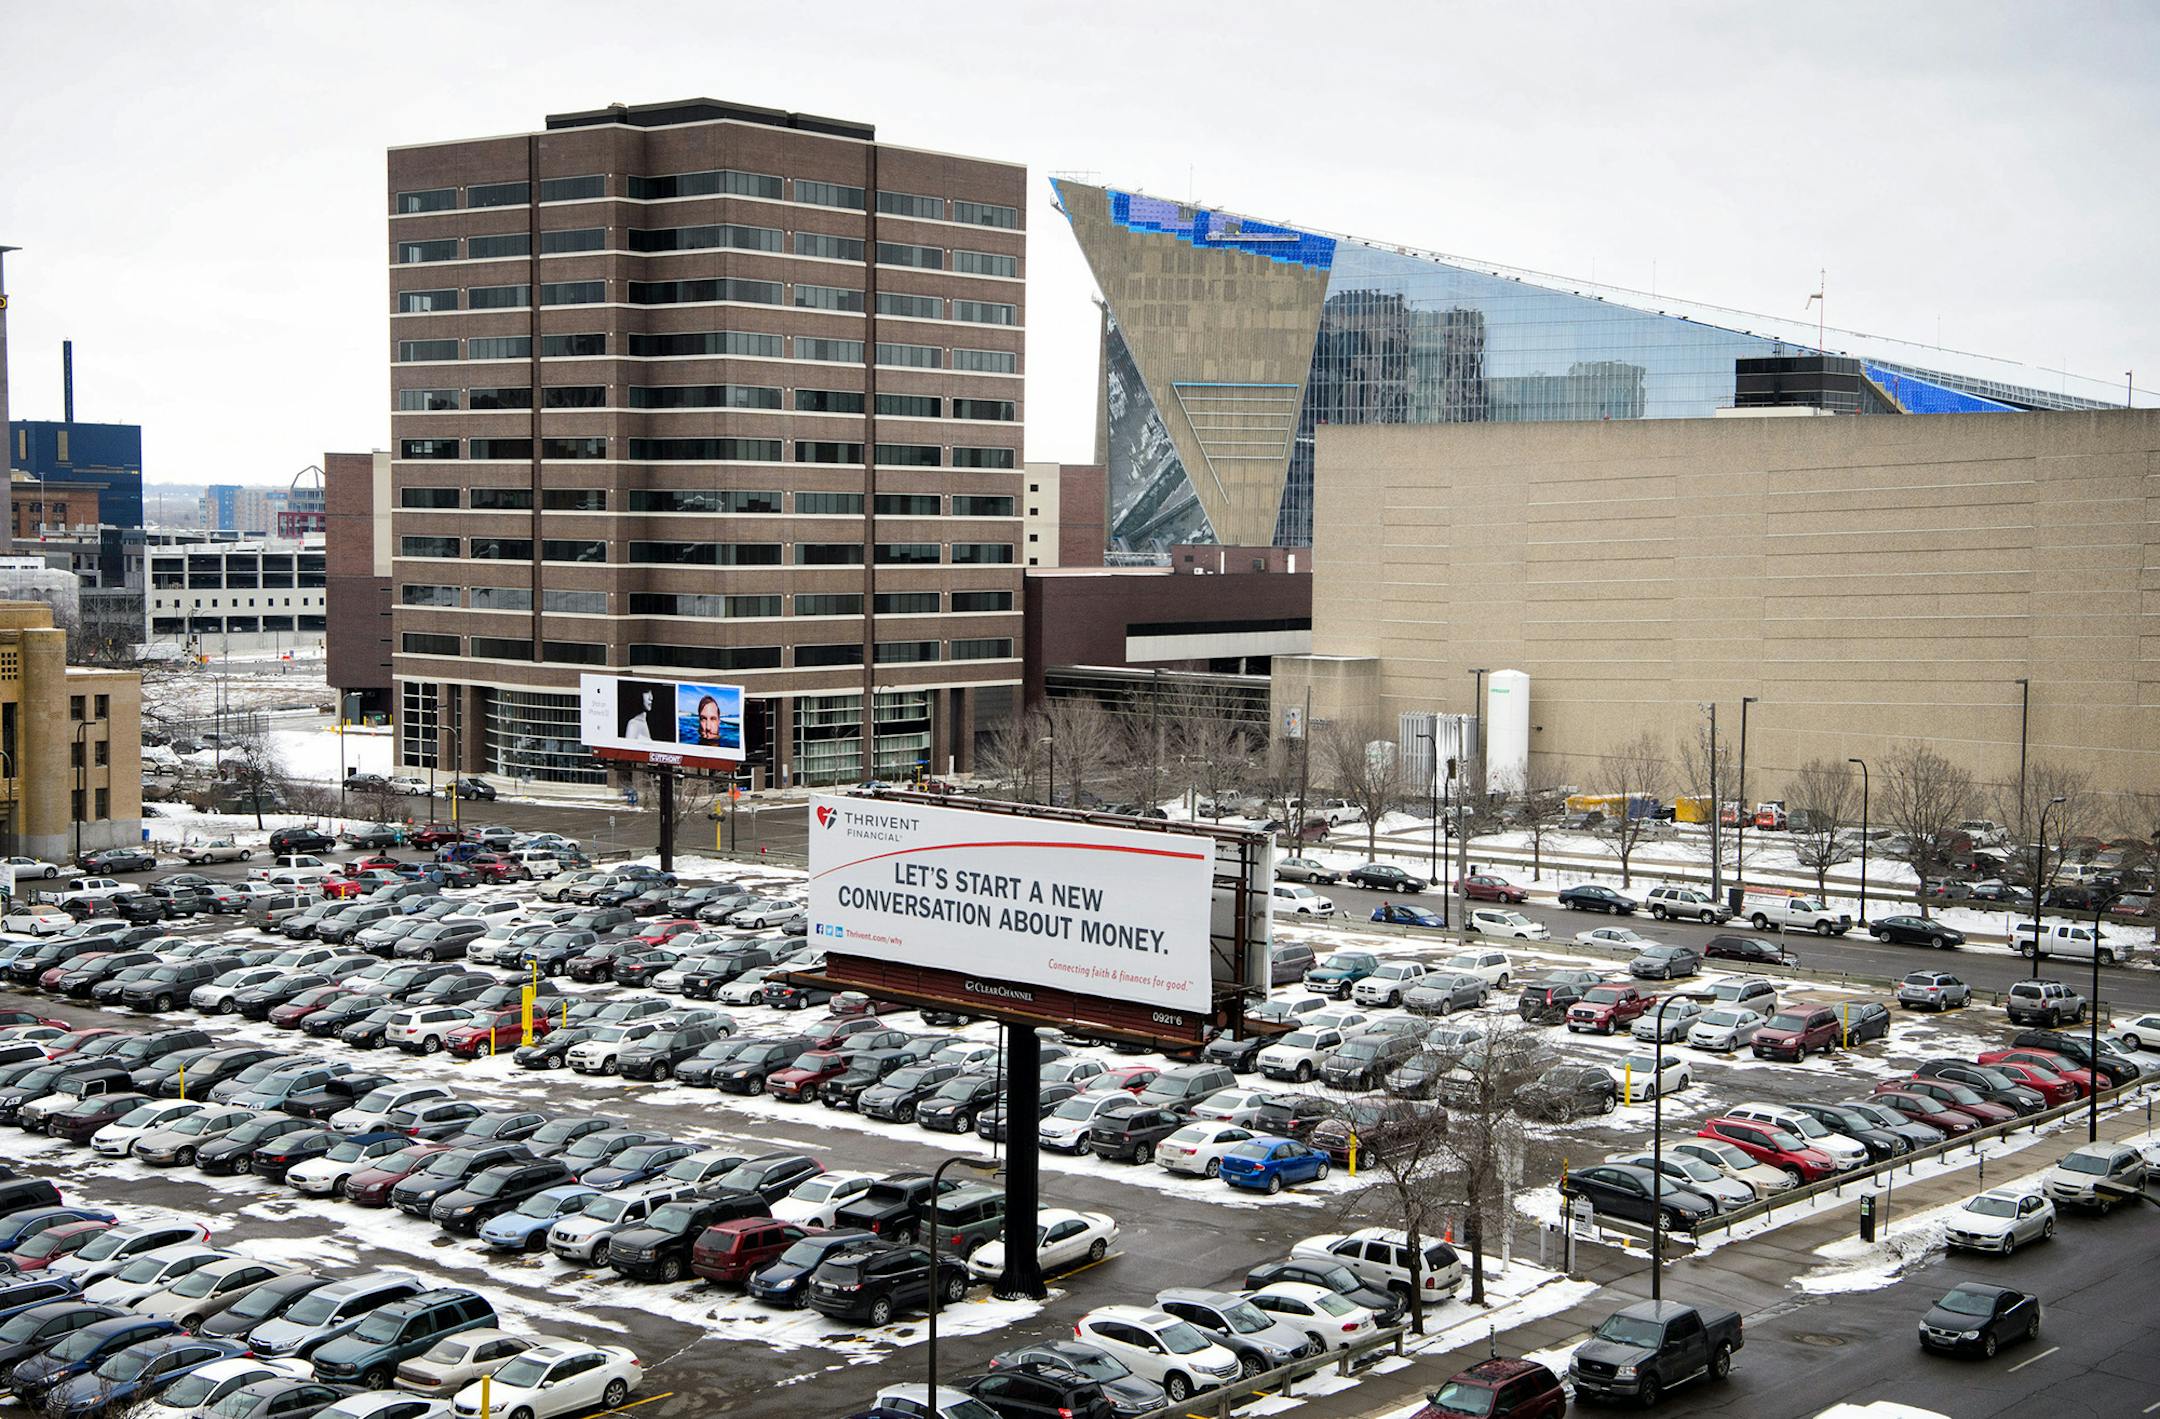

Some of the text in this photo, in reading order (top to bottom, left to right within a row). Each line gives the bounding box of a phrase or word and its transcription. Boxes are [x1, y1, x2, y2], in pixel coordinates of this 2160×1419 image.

[844, 811, 920, 831] THRIVENT
[847, 829, 901, 842] FINANCIAL
[895, 862, 1103, 912] LET'S START A NEW
[838, 885, 1168, 955] CONVERSATION ABOUT MONEY.
[846, 929, 903, 946] Thrivent.com/why
[1048, 958, 1090, 978] Connecting
[1091, 966, 1110, 979] faith
[1111, 970, 1117, 980] &
[1119, 970, 1151, 984] finances
[1152, 975, 1164, 988] for
